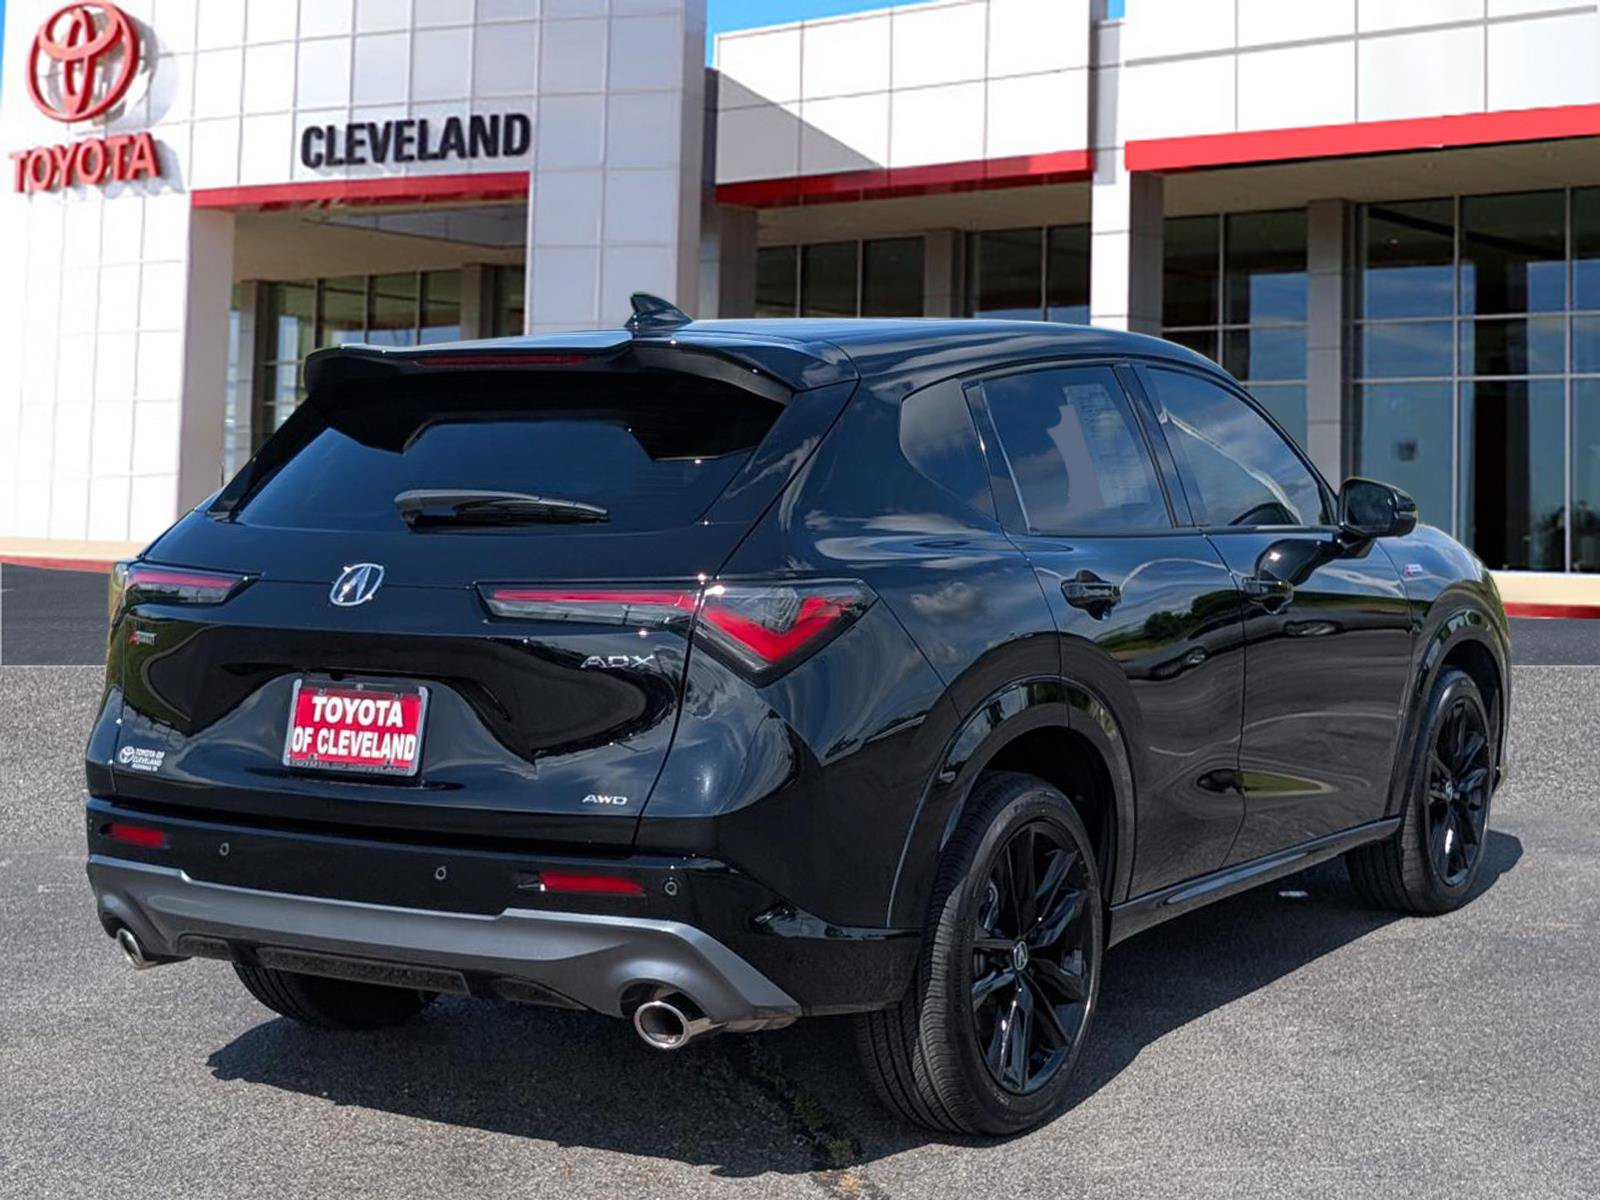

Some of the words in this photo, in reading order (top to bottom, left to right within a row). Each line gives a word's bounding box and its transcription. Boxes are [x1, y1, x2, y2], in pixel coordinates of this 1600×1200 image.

[301, 113, 531, 168] CLEVELAND
[9, 132, 160, 193] TOYOTA
[580, 655, 655, 668] ADX
[311, 696, 403, 727] TOYOTA
[292, 726, 315, 752] OF
[317, 728, 416, 760] CLEVELAND
[582, 794, 628, 805] AWD
